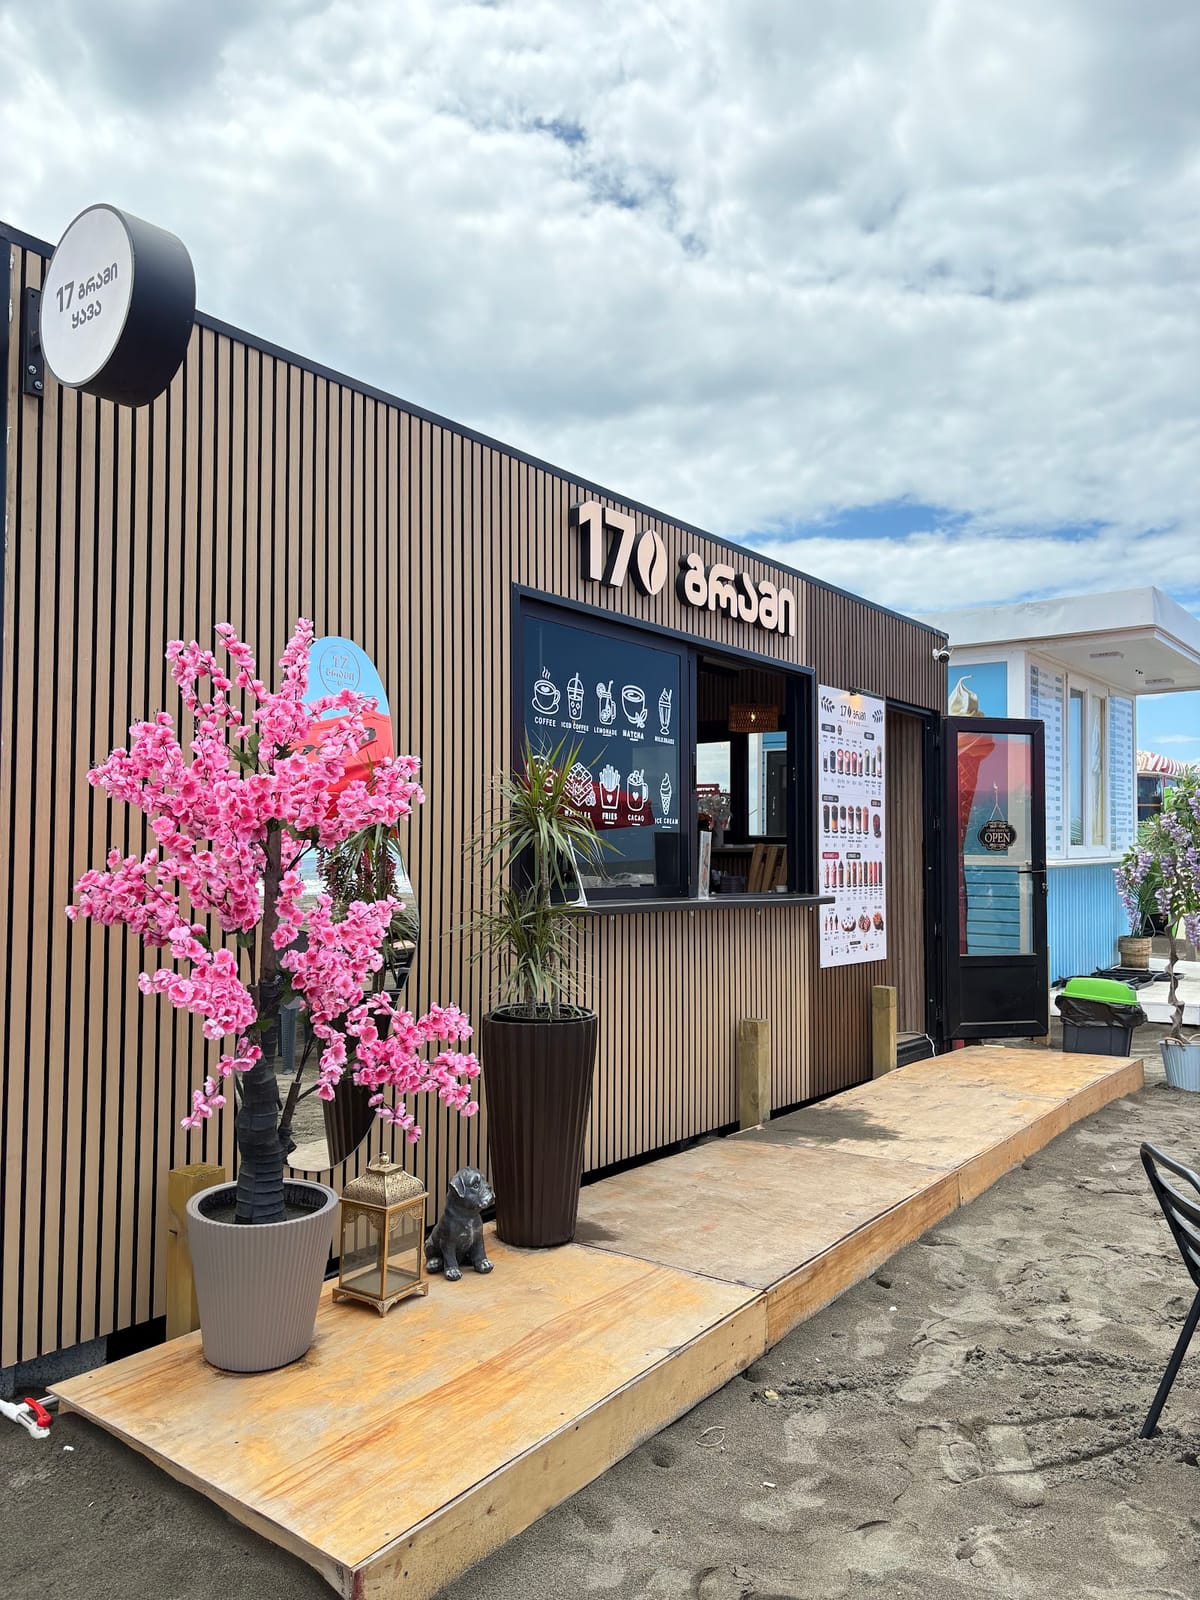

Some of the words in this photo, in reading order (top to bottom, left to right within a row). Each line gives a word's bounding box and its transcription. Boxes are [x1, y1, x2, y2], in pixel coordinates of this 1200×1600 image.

[56, 280, 74, 312] 17
[78, 263, 117, 299] გრამი
[72, 301, 101, 329] ყავა
[572, 500, 635, 587] 17
[678, 552, 795, 637] გრამი
[534, 716, 556, 727] COFFEE
[560, 721, 572, 729] ICED
[573, 723, 589, 732] COFFEE
[593, 727, 617, 736] LEMONADE
[622, 729, 645, 740] MATCHA
[602, 812, 618, 821] FRIES
[627, 814, 645, 822] CACAO
[654, 817, 662, 825] ICE
[663, 817, 679, 825] CREAM
[984, 832, 1011, 843] OPEN
